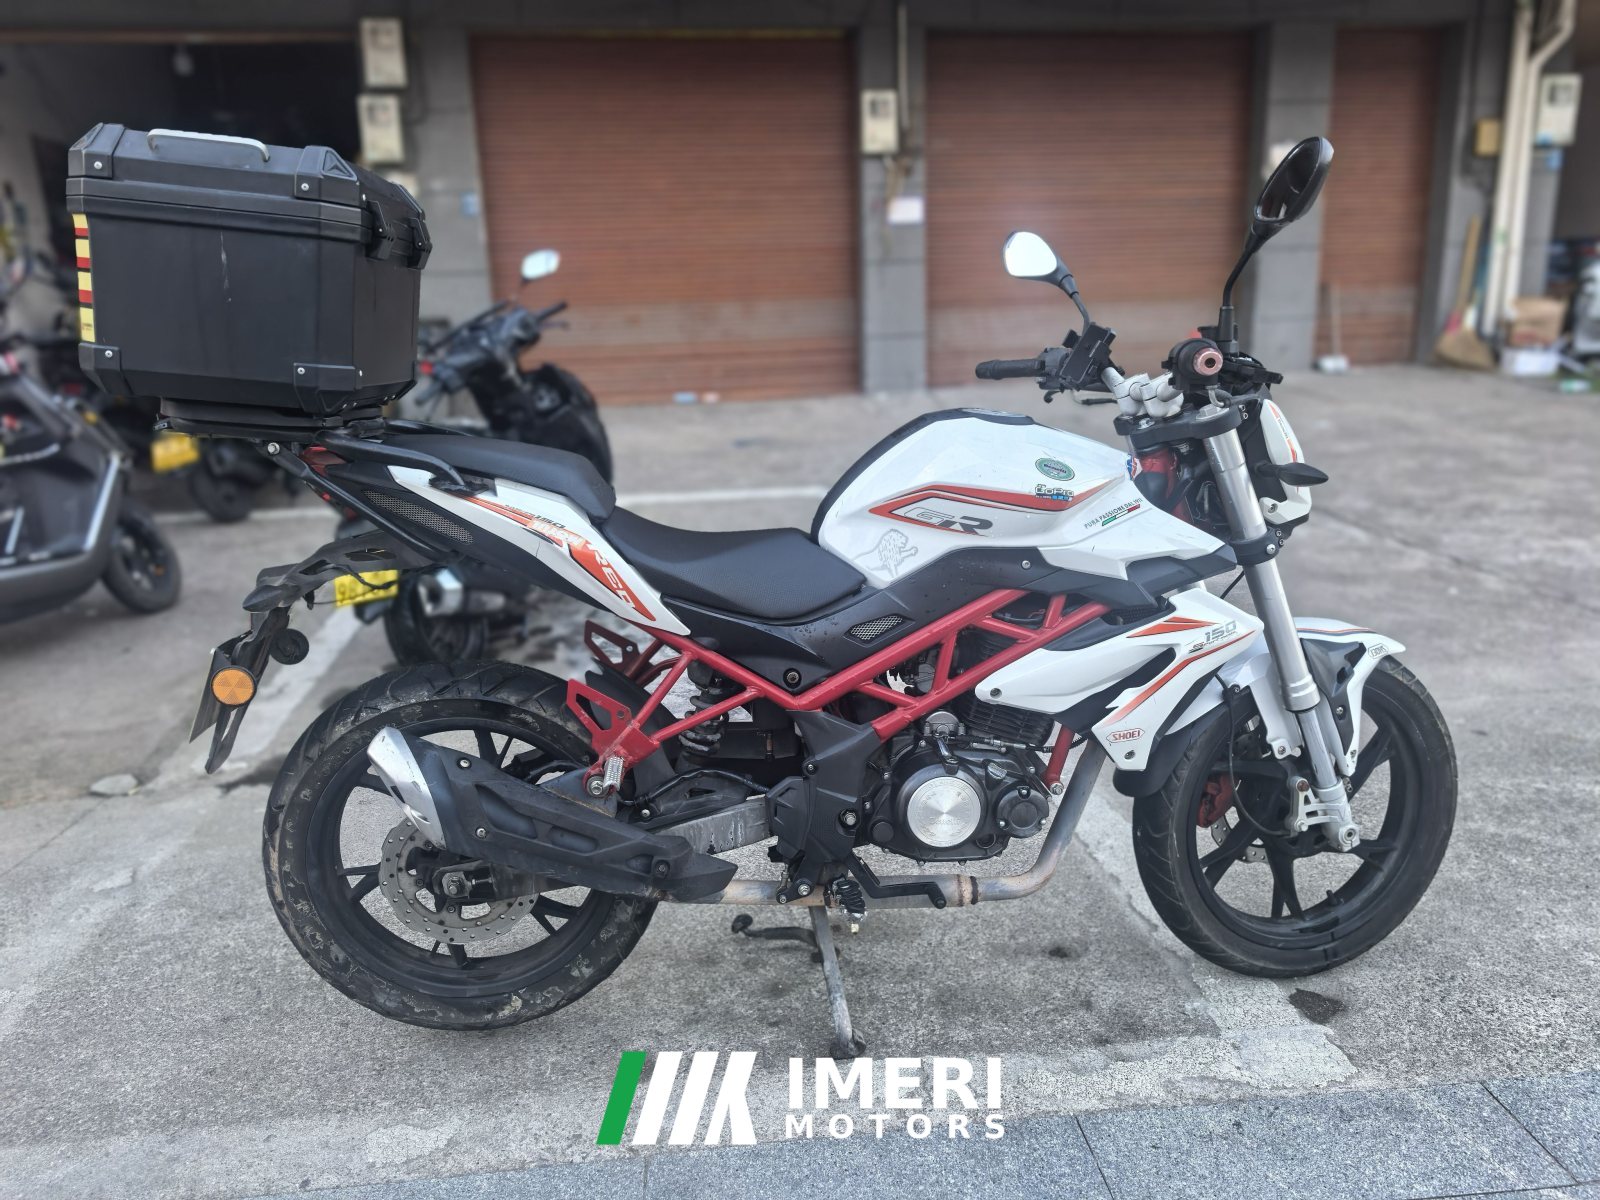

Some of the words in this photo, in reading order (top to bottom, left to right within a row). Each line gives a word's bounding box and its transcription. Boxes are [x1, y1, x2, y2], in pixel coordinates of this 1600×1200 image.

[1035, 484, 1074, 497] GoPro
[1084, 518, 1100, 529] PURA
[1099, 505, 1126, 521] PASSIONE
[1124, 502, 1134, 510] DAL
[1204, 620, 1237, 643] 150
[1112, 730, 1140, 741] SHOEI
